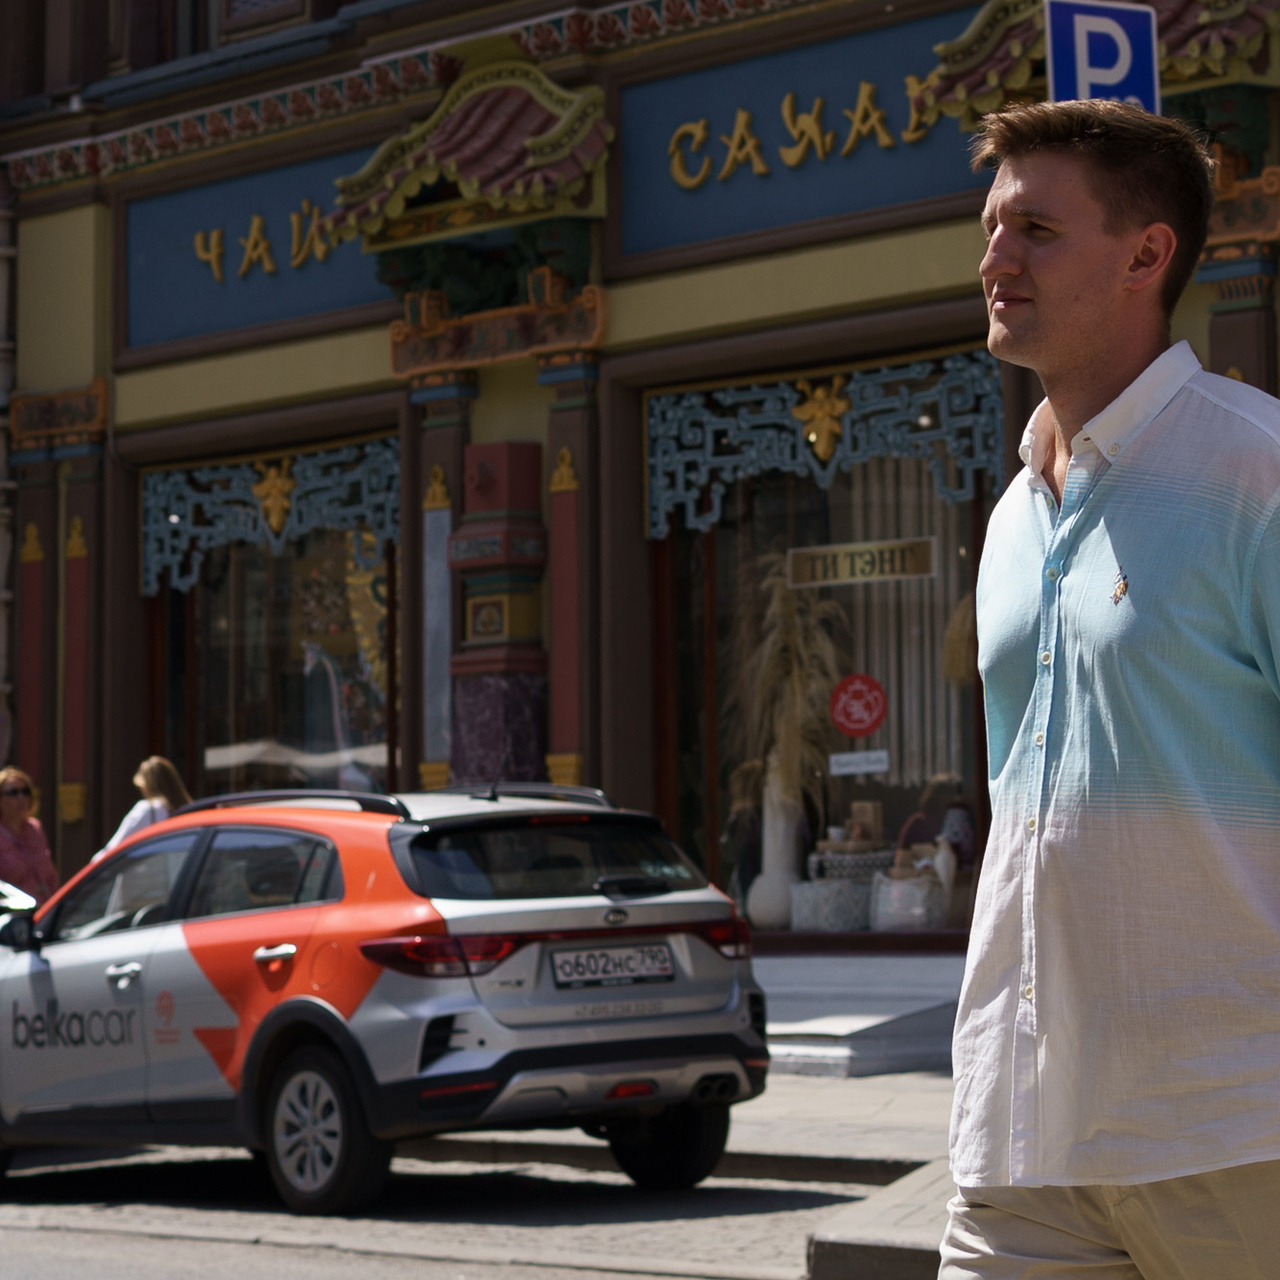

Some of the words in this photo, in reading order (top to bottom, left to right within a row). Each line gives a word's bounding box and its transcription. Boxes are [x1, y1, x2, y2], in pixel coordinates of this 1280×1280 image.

[1073, 13, 1133, 101] P
[194, 198, 331, 282] ЧАЙ
[844, 547, 914, 577] ТЭНГ
[12, 999, 136, 1048] belkacar
